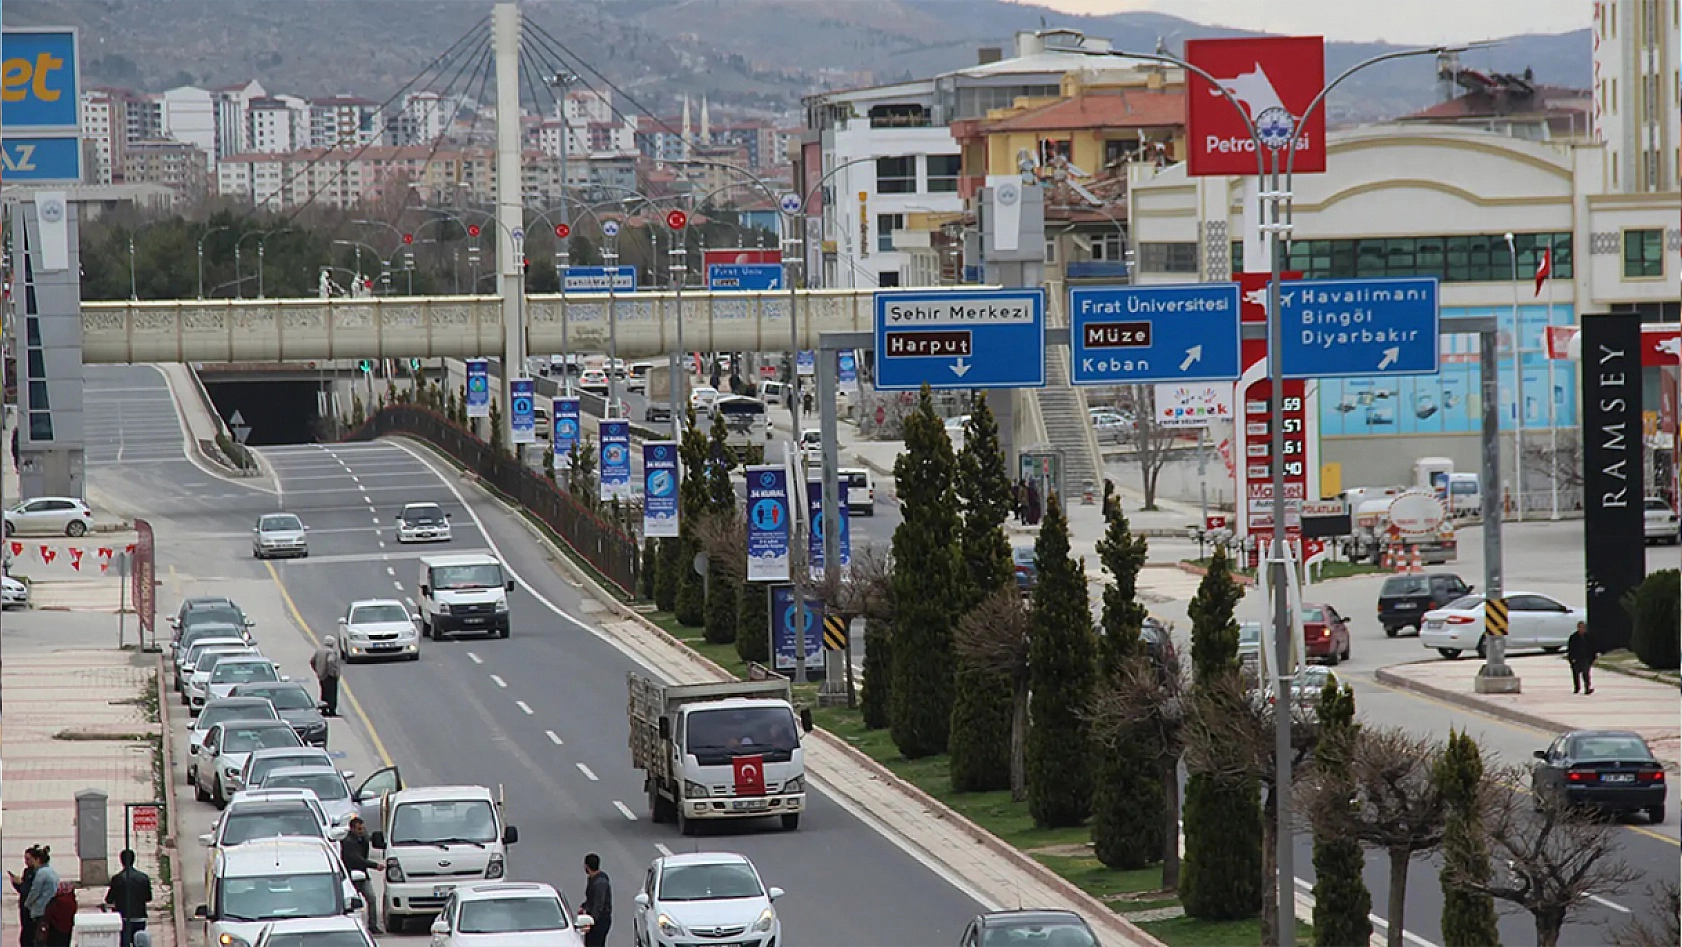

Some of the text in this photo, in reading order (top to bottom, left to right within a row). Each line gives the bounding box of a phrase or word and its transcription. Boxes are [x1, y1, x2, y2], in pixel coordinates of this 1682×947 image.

[1082, 296, 1229, 314] Fırat Üniversitesi
[1302, 288, 1426, 304] Havalimanı
[891, 304, 1029, 322] Şehir Merkezi
[1302, 308, 1373, 326] Bingöl
[1089, 328, 1146, 343] Müze
[1302, 328, 1418, 348] Diyarbakır
[891, 337, 968, 355] Harput
[1083, 358, 1149, 372] Keban
[1599, 344, 1627, 508] RAMSEY
